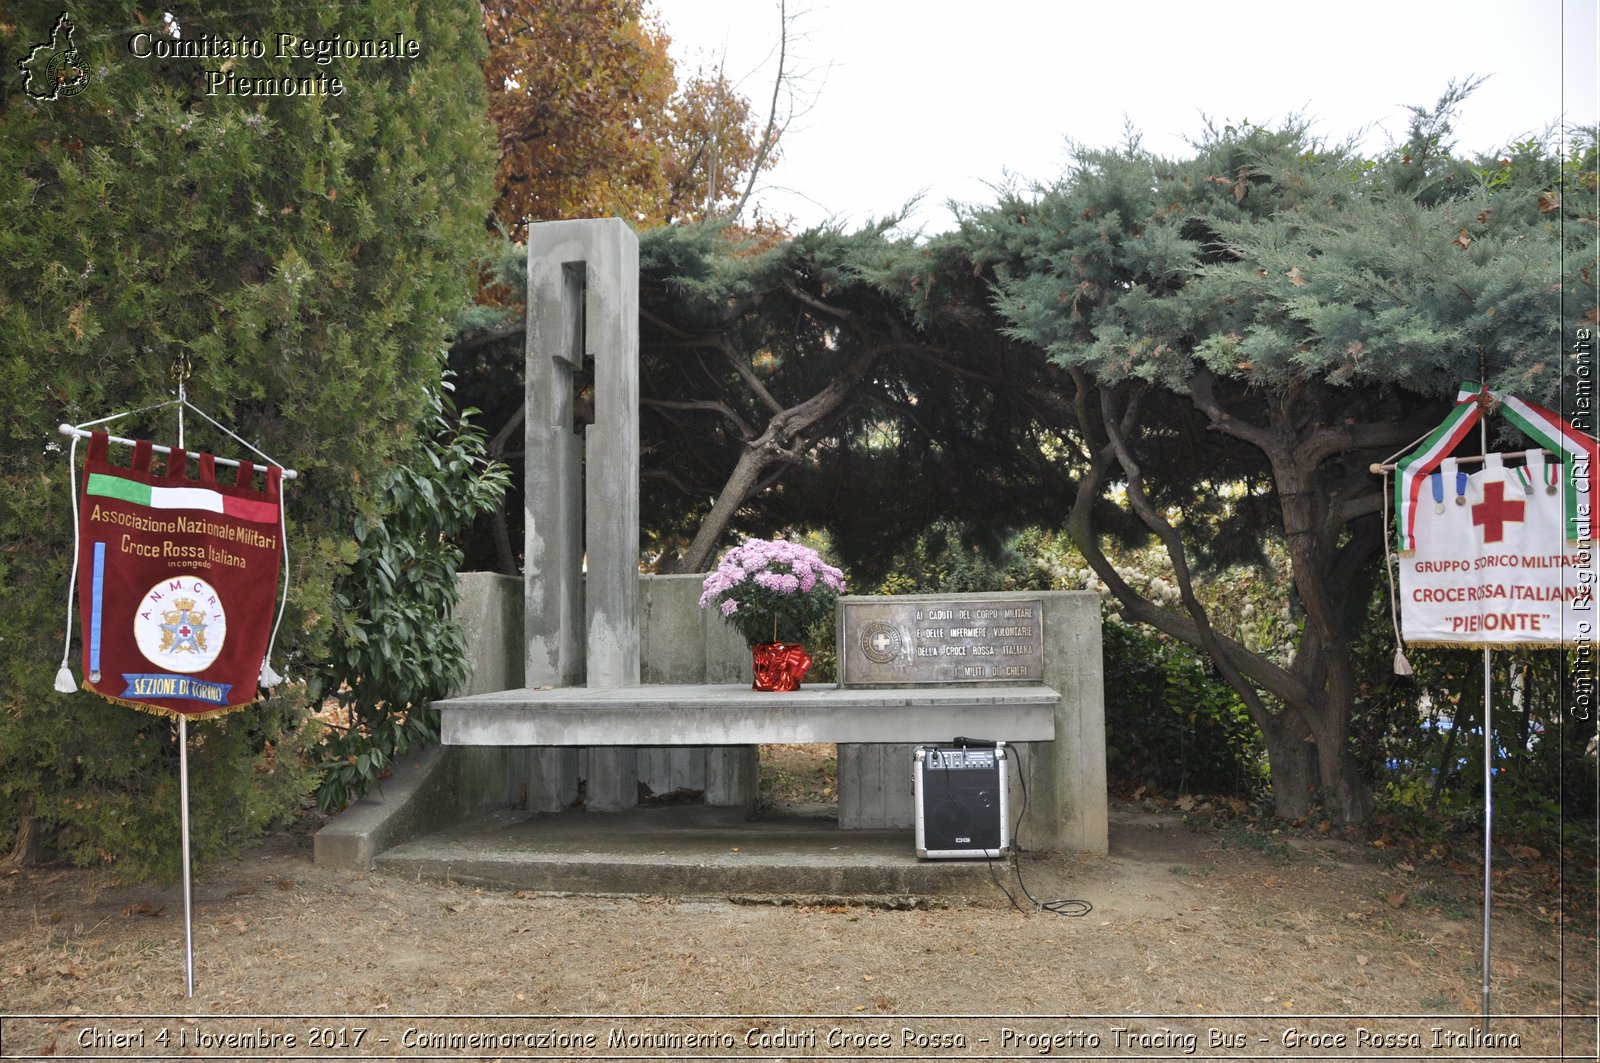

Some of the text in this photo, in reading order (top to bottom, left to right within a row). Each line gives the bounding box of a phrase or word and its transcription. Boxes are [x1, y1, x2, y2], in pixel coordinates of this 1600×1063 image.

[90, 504, 276, 550] Associazione Nazionale Militari
[121, 534, 246, 569] Croce Rossa Italiana
[1415, 560, 1470, 573] GRUPPO
[1413, 587, 1465, 603] CROCE
[1468, 583, 1506, 601] ROSSA
[916, 608, 1033, 620] AI CADUTI DEL CORPO MILITARE
[916, 626, 1032, 638] E DELLE INFERMIERE VOLONTARIE
[917, 644, 1033, 656] DELLA CROCE ROSSA ITALIANA
[964, 666, 985, 677] MILITI
[1006, 665, 1029, 676] CHIERI
[134, 678, 222, 702] SEZIONE DI TORINO
